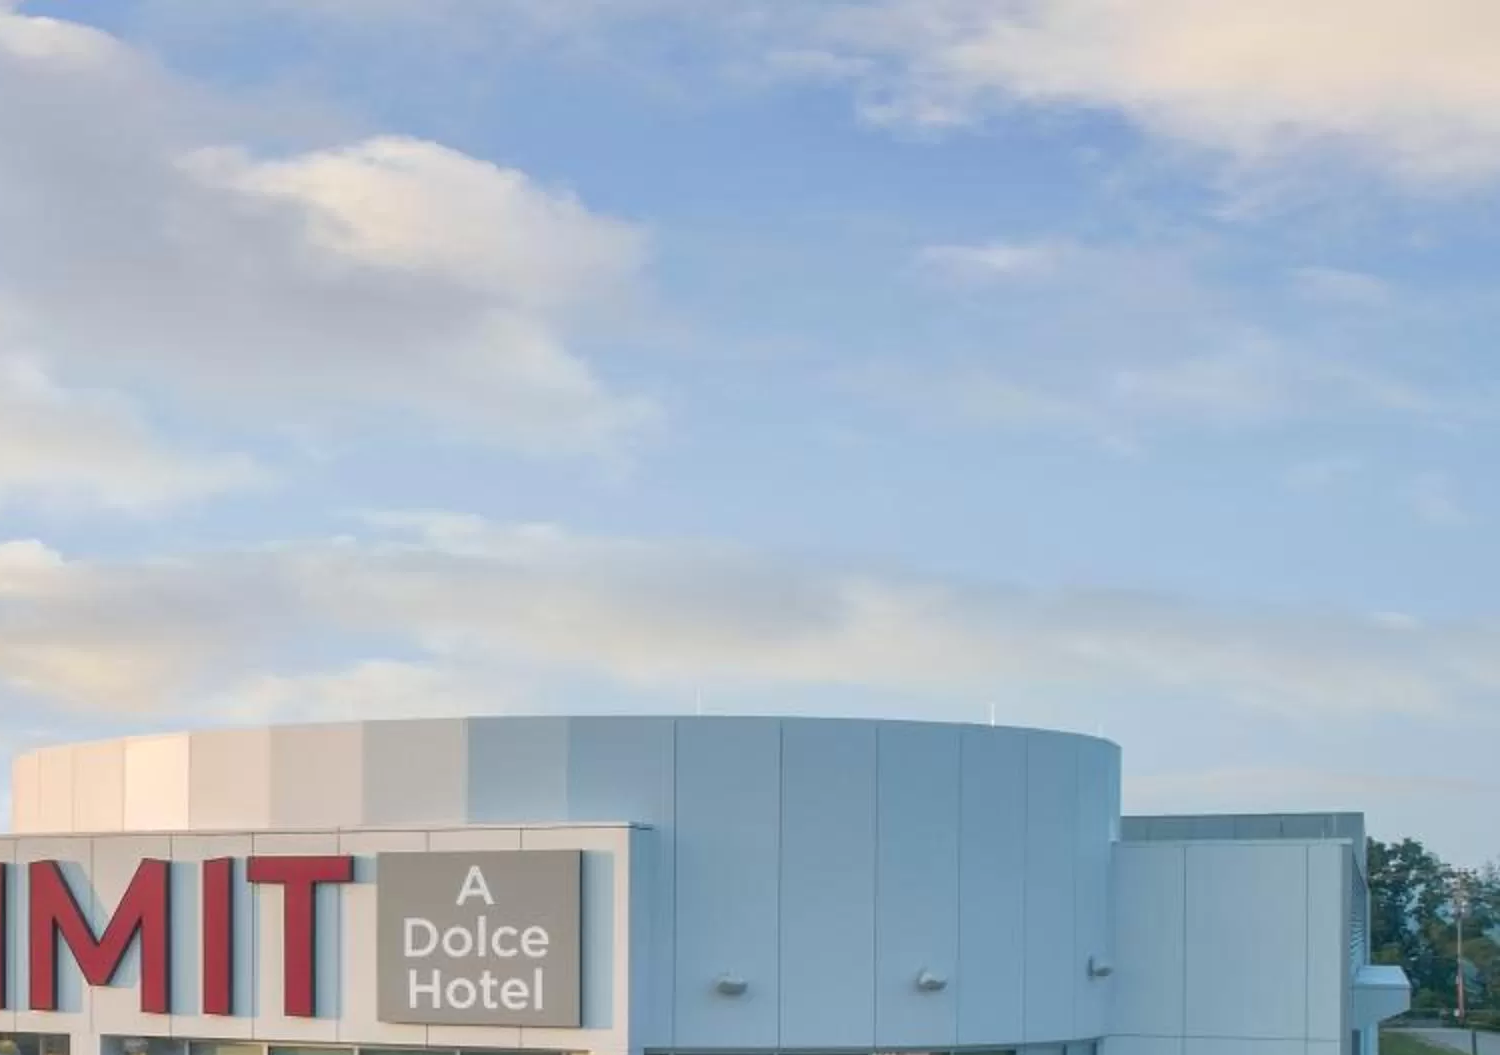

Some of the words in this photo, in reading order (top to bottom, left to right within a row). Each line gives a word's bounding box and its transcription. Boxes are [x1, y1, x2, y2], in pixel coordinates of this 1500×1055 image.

[455, 865, 495, 906] A
[403, 915, 550, 959] Dolce
[408, 968, 544, 1010] Hotel
